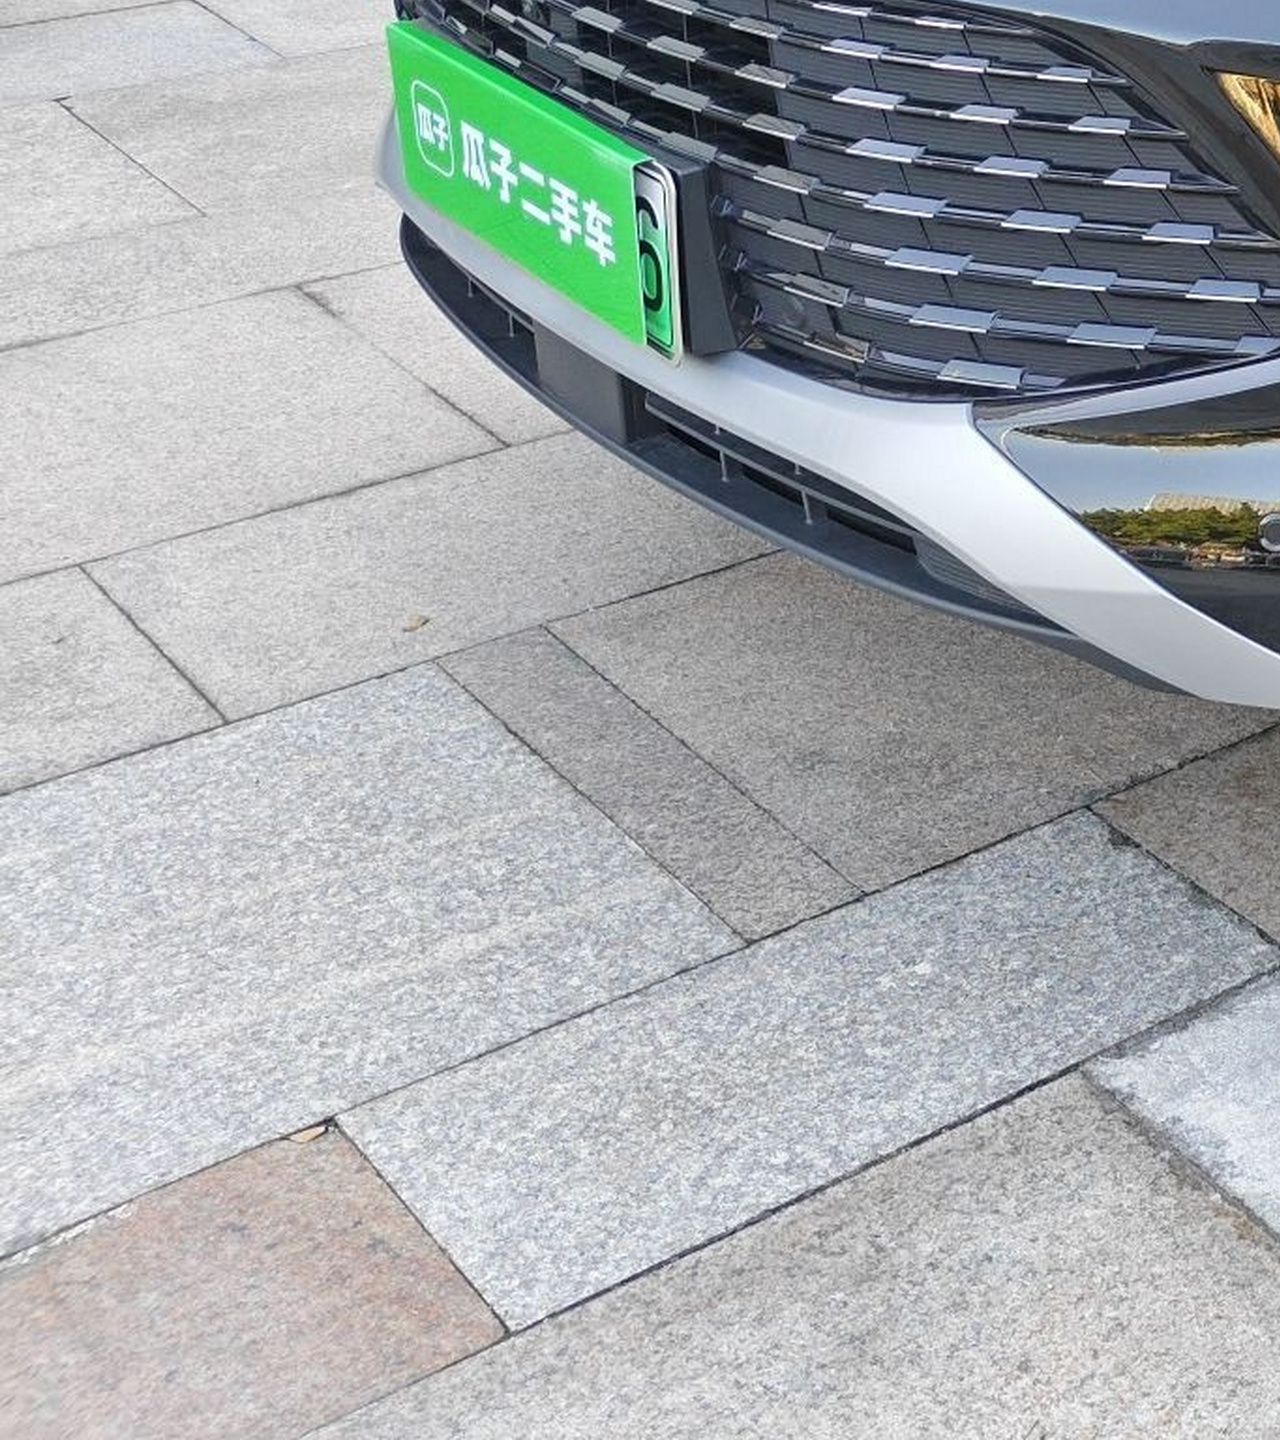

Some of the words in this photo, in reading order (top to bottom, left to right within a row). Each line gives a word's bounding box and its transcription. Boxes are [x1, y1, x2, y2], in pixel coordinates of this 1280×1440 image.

[417, 102, 449, 152] 瓜子
[460, 119, 616, 267] 瓜子二手车
